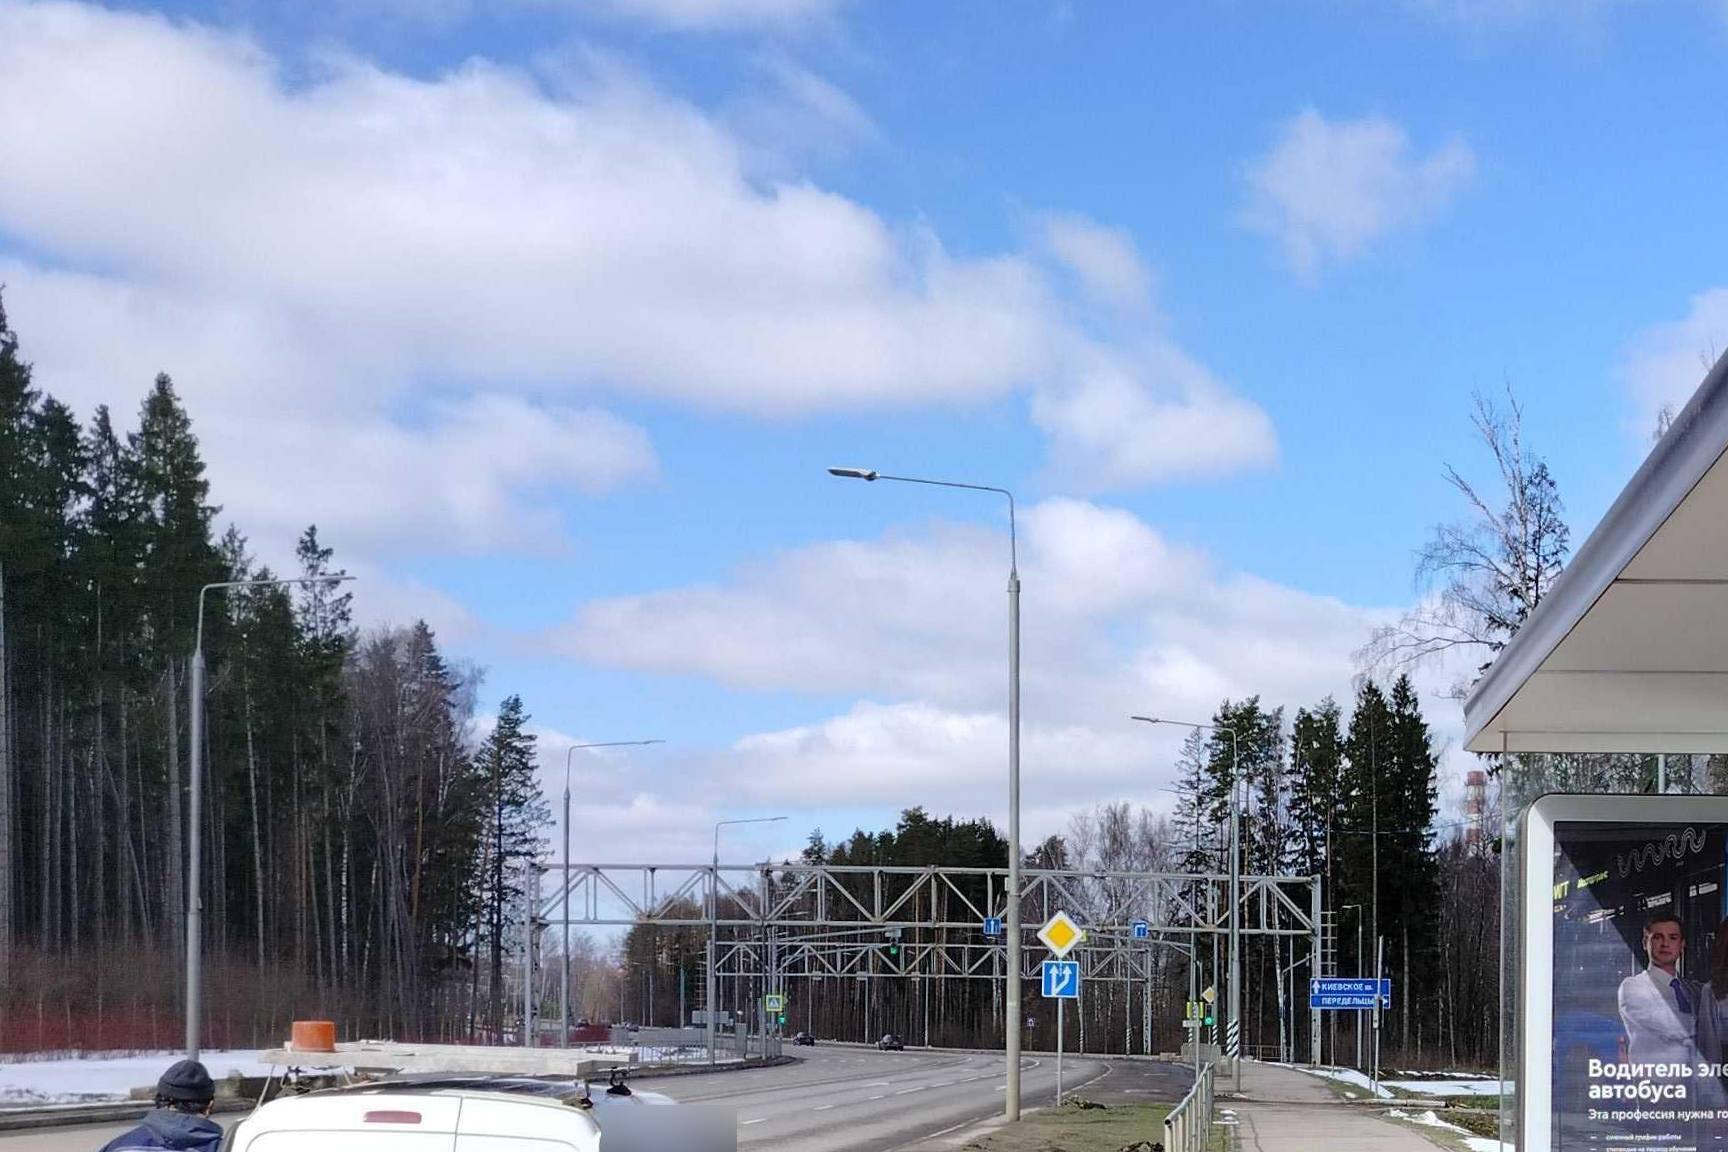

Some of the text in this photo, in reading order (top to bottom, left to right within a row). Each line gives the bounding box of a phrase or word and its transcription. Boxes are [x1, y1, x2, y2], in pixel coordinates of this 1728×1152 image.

[1321, 983, 1364, 991] КИЕВСКОЕ
[1588, 1058, 1693, 1080] Водитель
[1588, 1081, 1687, 1104] автобуса
[1588, 1108, 1609, 1119] Эта
[1611, 1109, 1675, 1121] профессия
[1677, 1110, 1715, 1121] нужна
